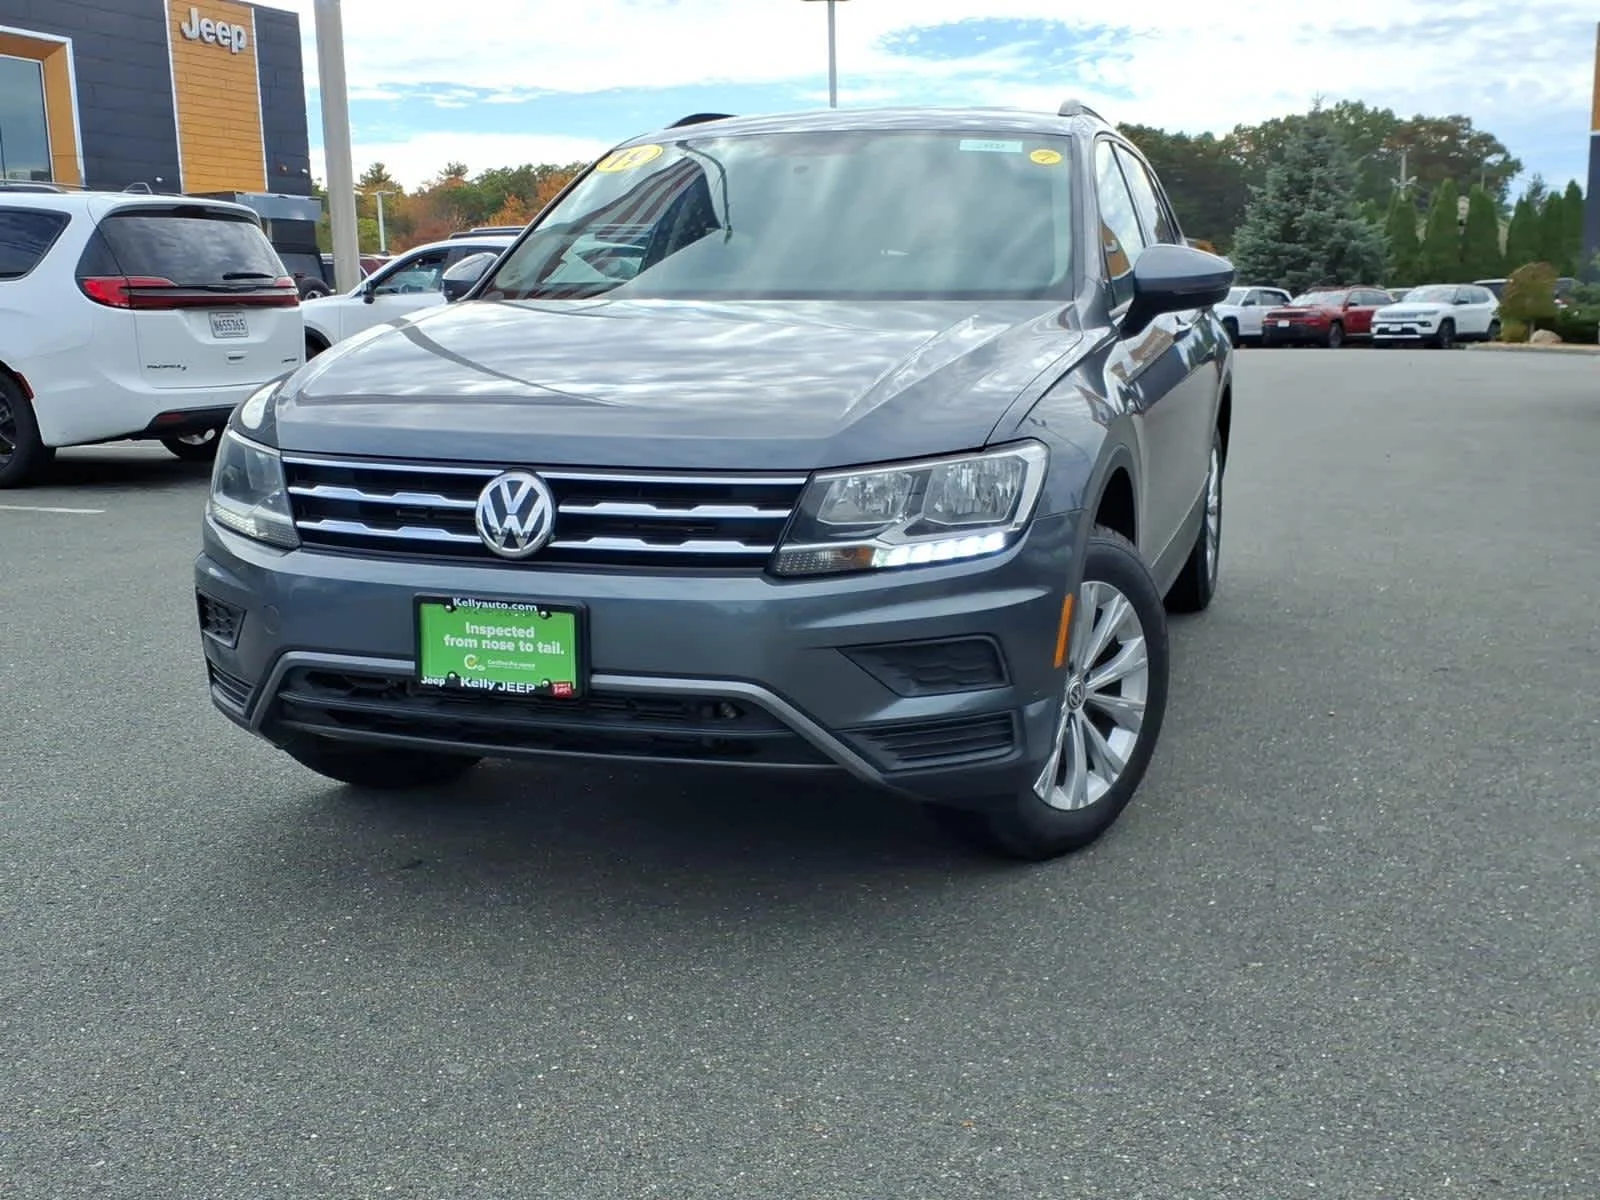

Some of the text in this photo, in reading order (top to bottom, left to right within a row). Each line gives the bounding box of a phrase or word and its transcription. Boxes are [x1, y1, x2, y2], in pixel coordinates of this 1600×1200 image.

[181, 7, 247, 54] Jeep
[453, 597, 538, 612] Kellyauto.com
[465, 621, 535, 638] Inspected
[444, 634, 565, 655] from nose to tail.
[421, 675, 446, 686] Jeep
[460, 676, 496, 691] Kelly
[498, 681, 536, 694] JEEP
